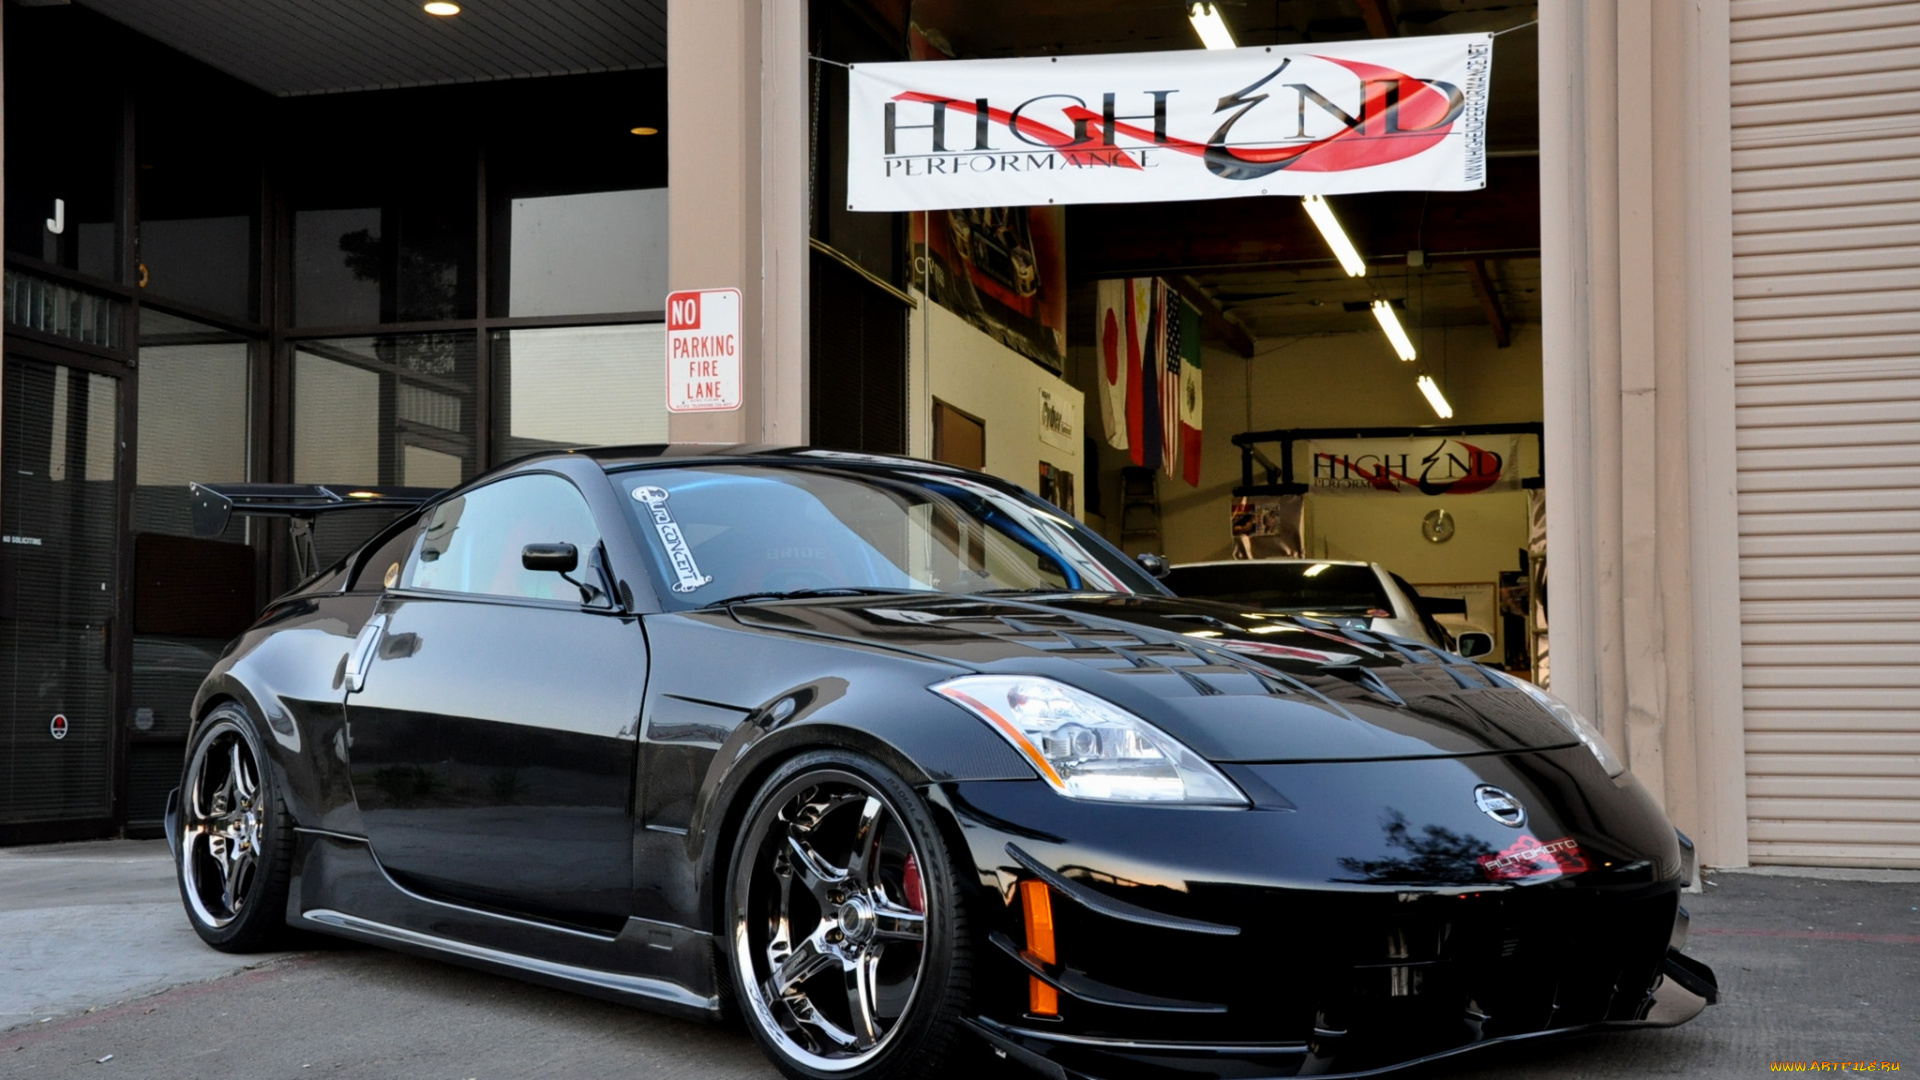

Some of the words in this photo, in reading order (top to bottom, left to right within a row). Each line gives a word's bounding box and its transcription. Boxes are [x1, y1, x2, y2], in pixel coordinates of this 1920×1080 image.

[884, 90, 1180, 156] HIGH
[884, 149, 1160, 178] PERFORMANCE
[46, 198, 65, 234] J
[672, 298, 697, 326] NO
[673, 334, 735, 360] PARKING
[689, 360, 719, 378] FIRE
[687, 381, 722, 400] LANE
[1313, 453, 1410, 480] HIGH
[766, 546, 827, 561] BRIDE
